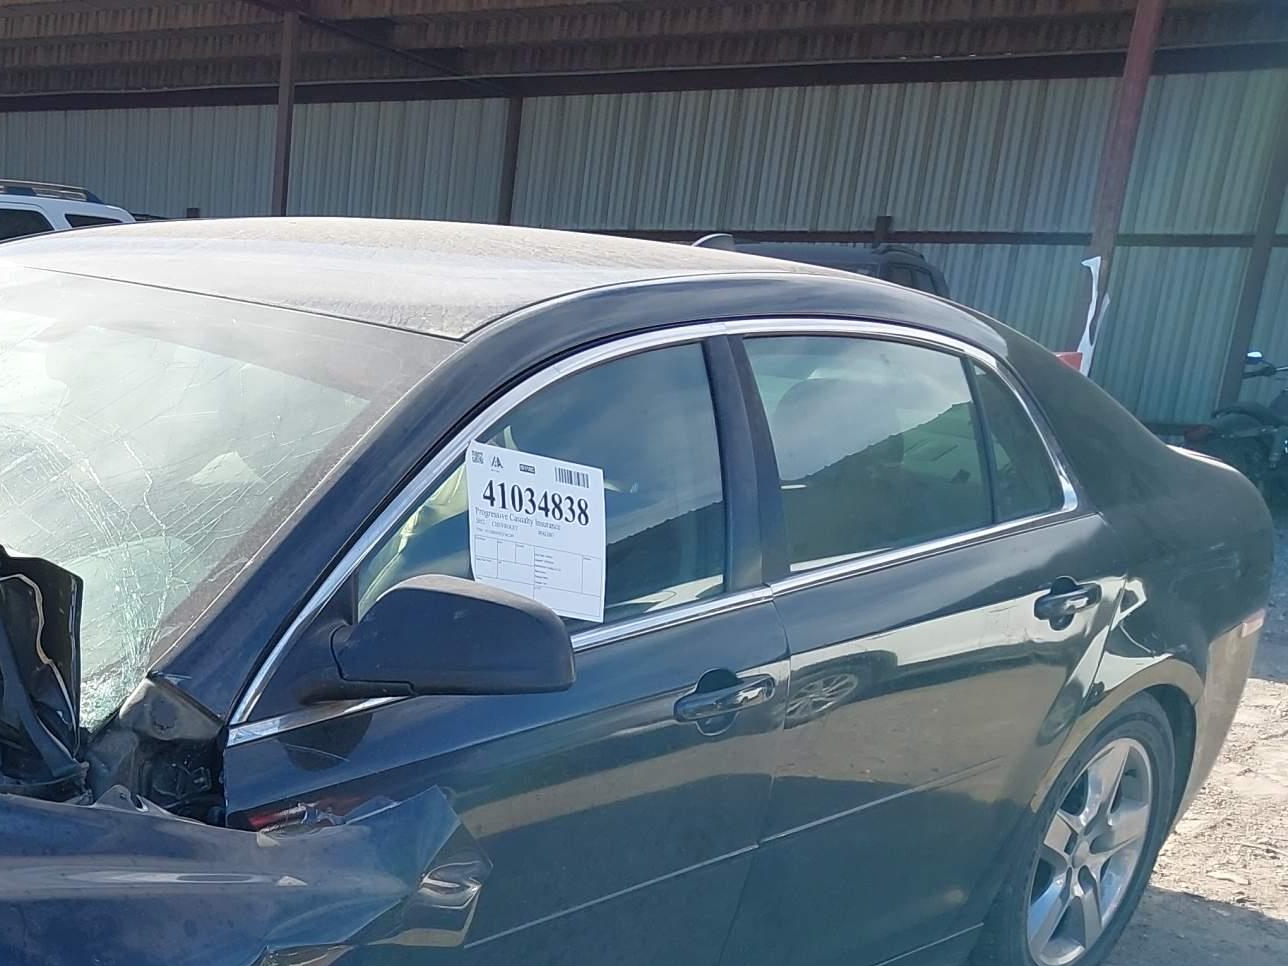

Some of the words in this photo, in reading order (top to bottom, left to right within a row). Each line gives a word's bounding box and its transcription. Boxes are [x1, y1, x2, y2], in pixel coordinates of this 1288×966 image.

[475, 506, 508, 521] Progressive
[509, 513, 534, 528] Casualty
[535, 519, 561, 531] Insurance
[482, 479, 590, 526] 41034838
